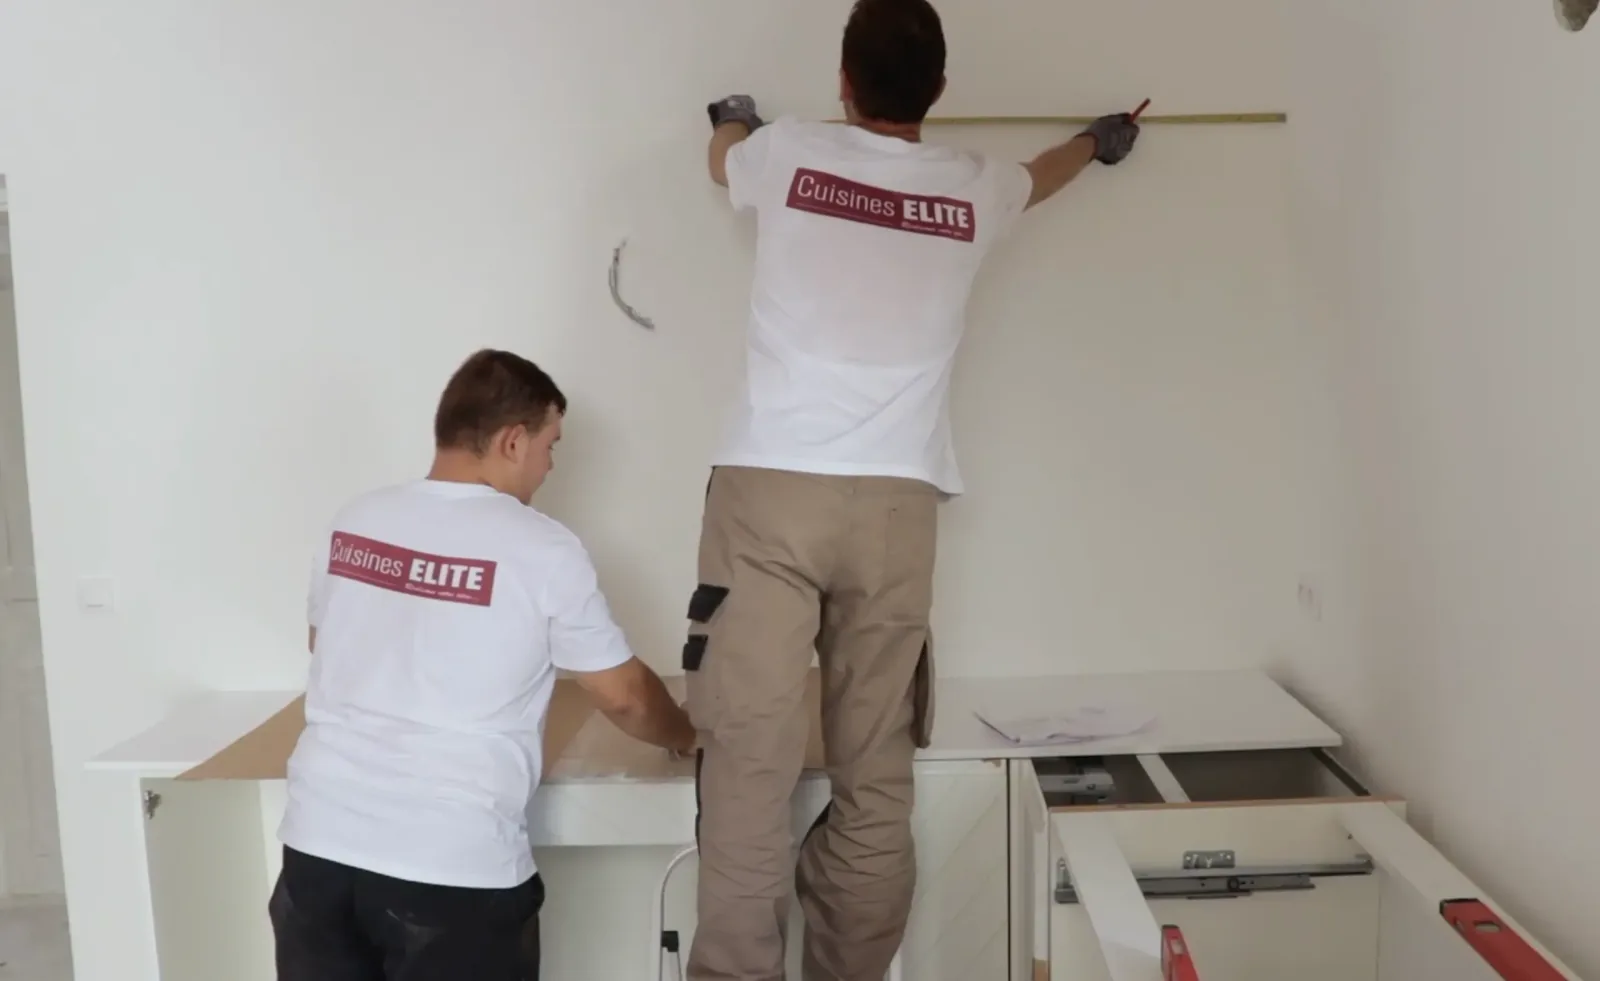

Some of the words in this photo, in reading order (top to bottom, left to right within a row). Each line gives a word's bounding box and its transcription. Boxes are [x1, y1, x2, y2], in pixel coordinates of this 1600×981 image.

[797, 174, 896, 217] Cuisines
[903, 199, 970, 228] ELITE
[331, 538, 404, 577] Cuisines
[408, 558, 485, 591] ELITE
